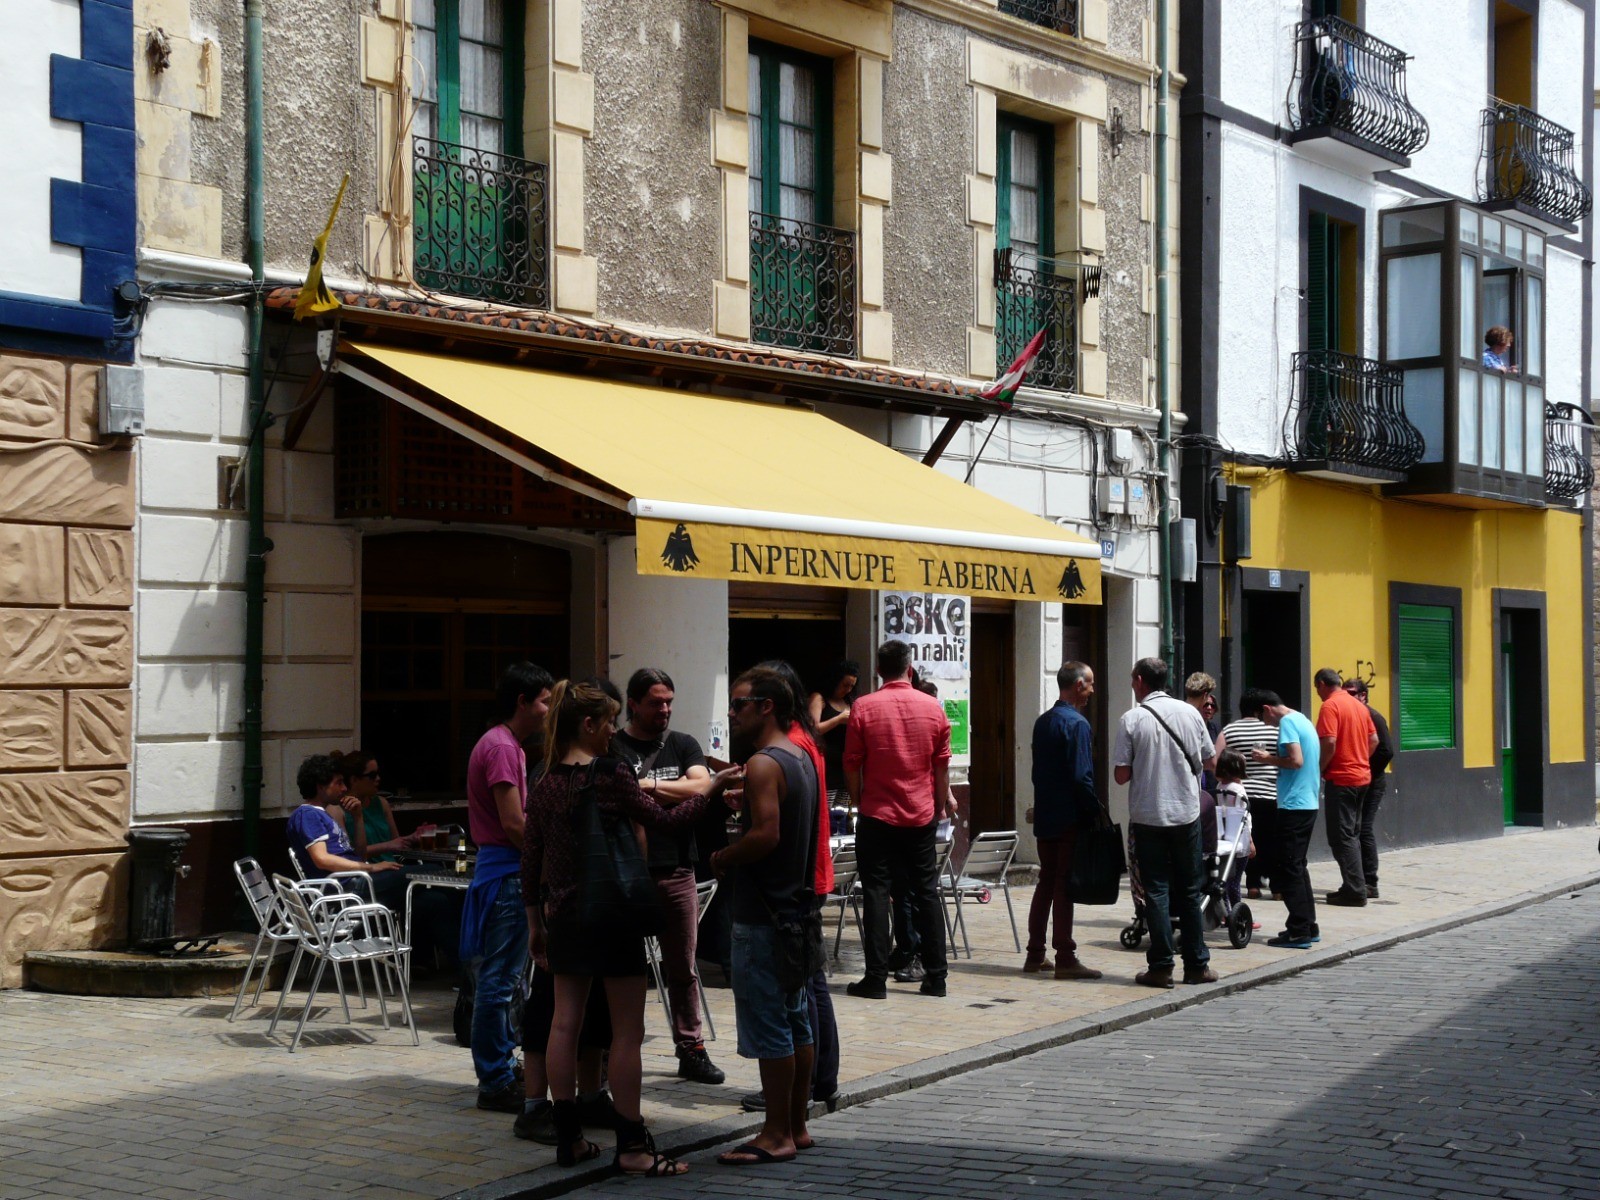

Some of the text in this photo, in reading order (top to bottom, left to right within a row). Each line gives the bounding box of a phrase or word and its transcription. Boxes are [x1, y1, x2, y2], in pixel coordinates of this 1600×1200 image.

[1104, 541, 1112, 555] 19
[729, 542, 1036, 594] INPERNUPE TABERNA
[883, 593, 966, 636] aske
[921, 636, 965, 662] nahi?
